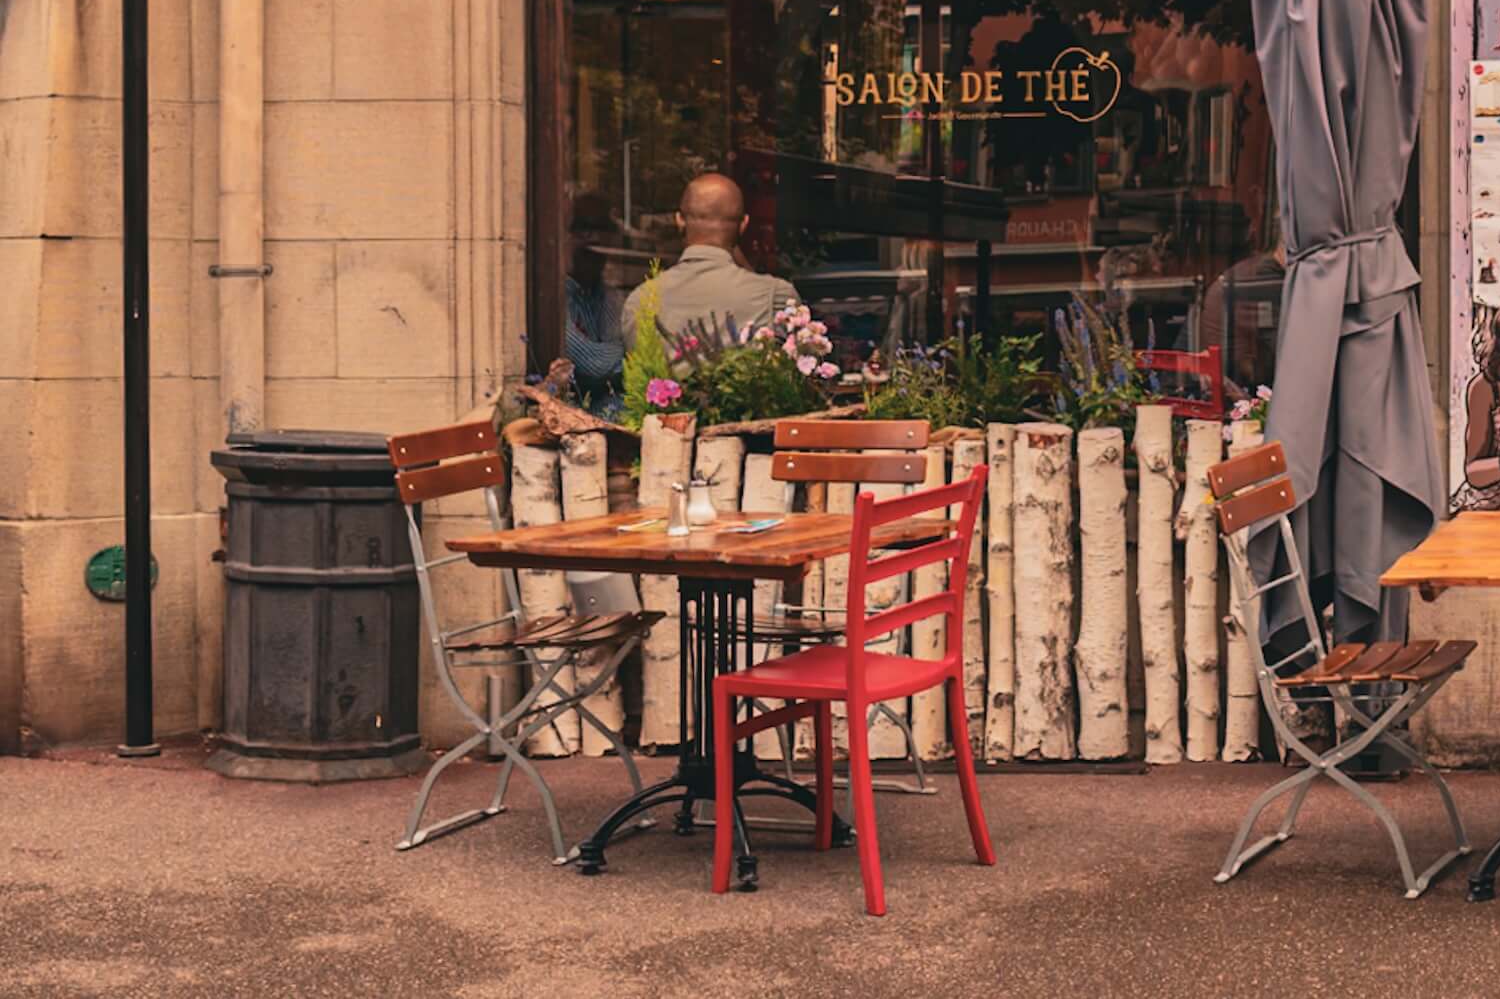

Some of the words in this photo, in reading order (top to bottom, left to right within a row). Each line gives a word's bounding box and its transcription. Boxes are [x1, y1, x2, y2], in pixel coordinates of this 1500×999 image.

[835, 71, 944, 107] SALON
[960, 71, 1003, 103] DE
[1016, 62, 1090, 102] THÉ
